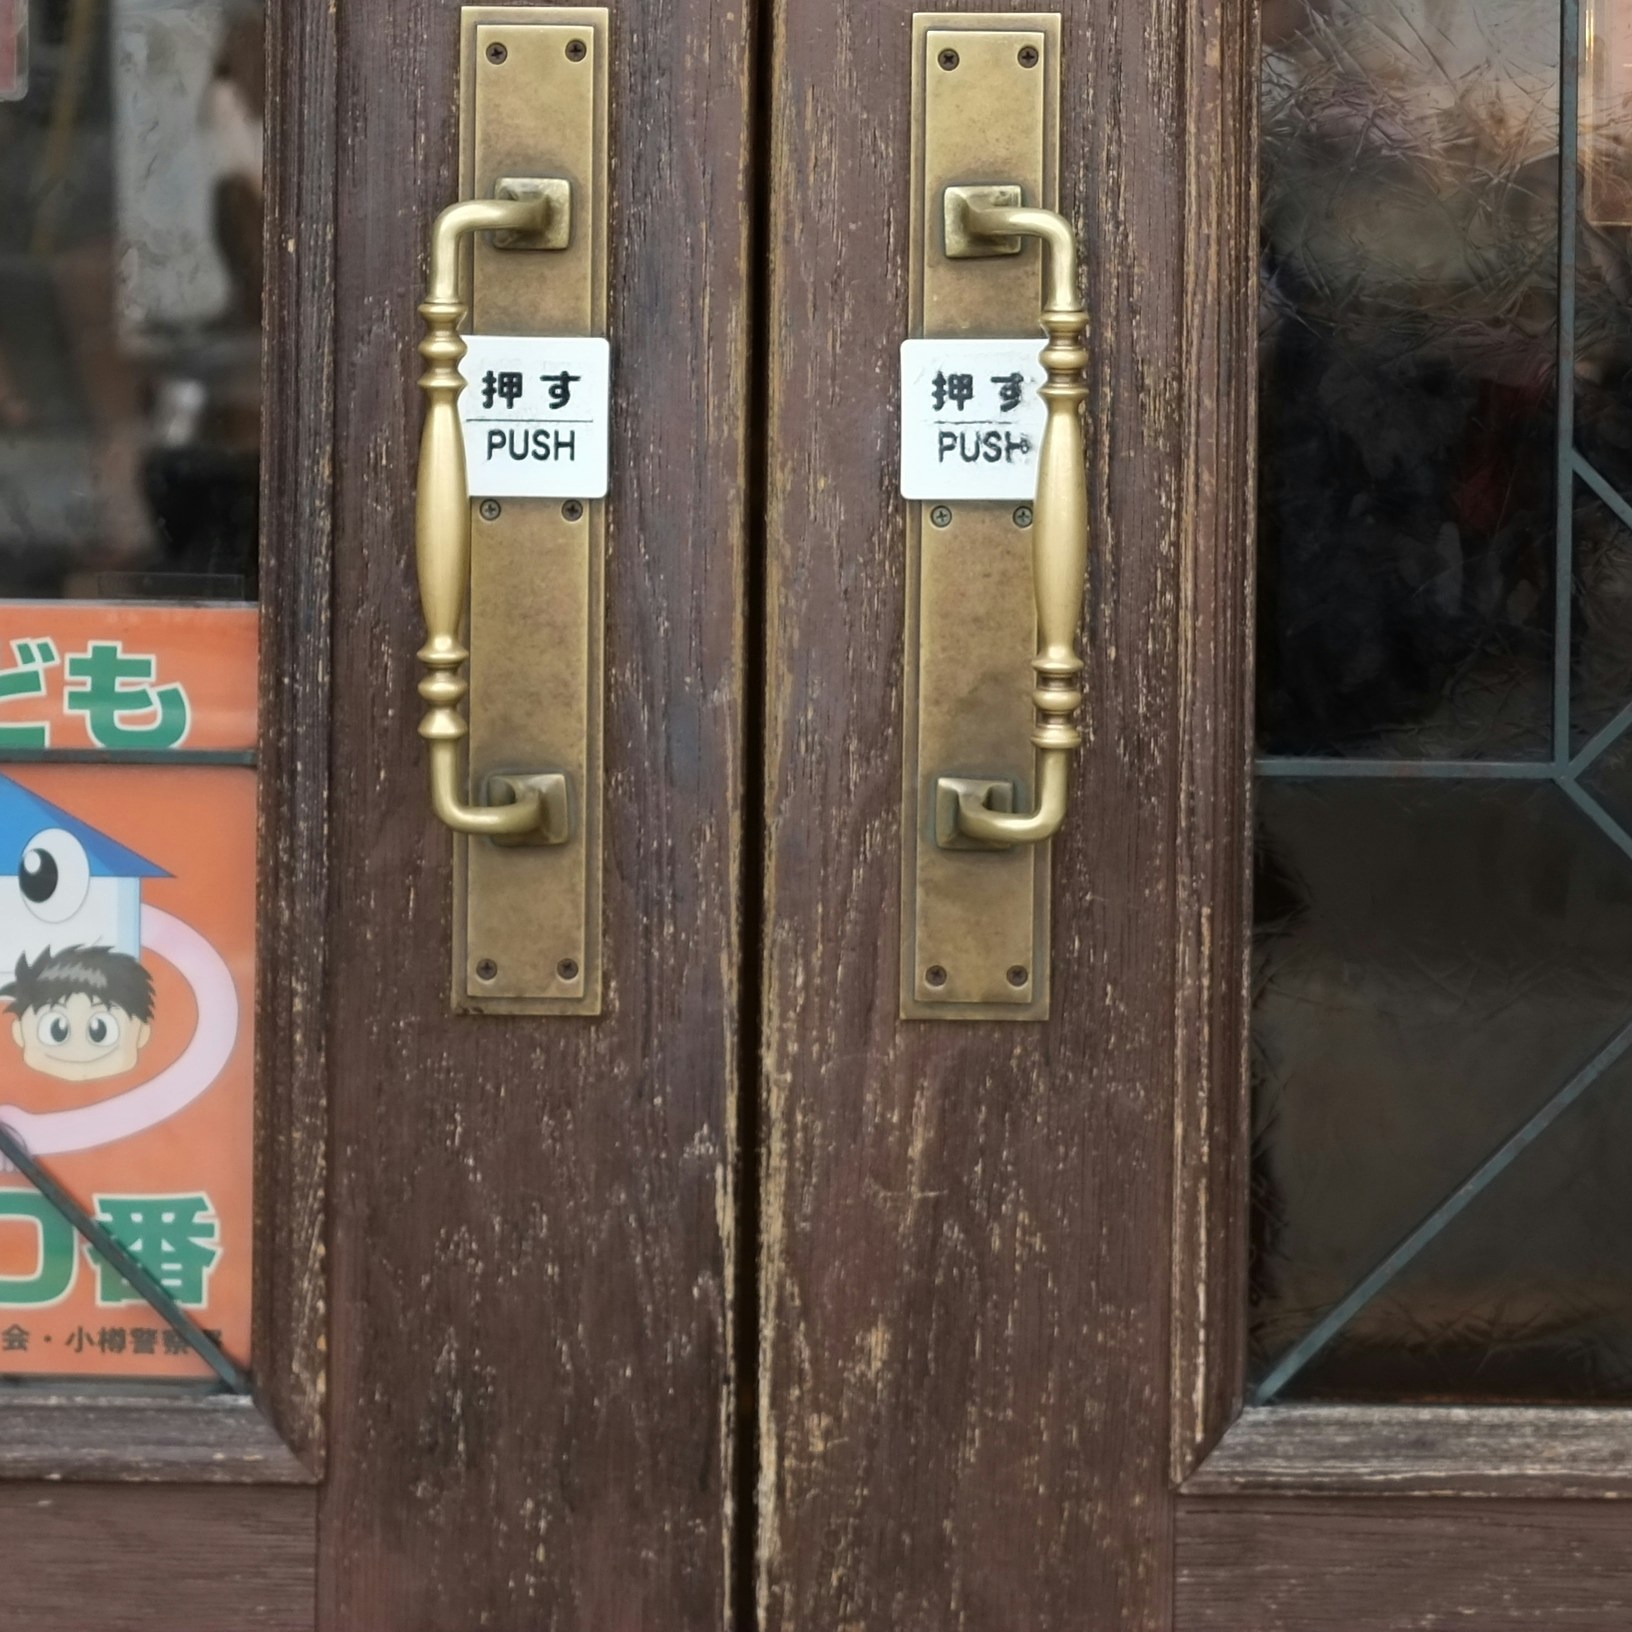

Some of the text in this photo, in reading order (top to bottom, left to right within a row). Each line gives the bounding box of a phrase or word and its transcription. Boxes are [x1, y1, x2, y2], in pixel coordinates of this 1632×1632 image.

[480, 369, 582, 411] 押す
[485, 428, 577, 462] PUSH
[937, 430, 1030, 464] PUSH
